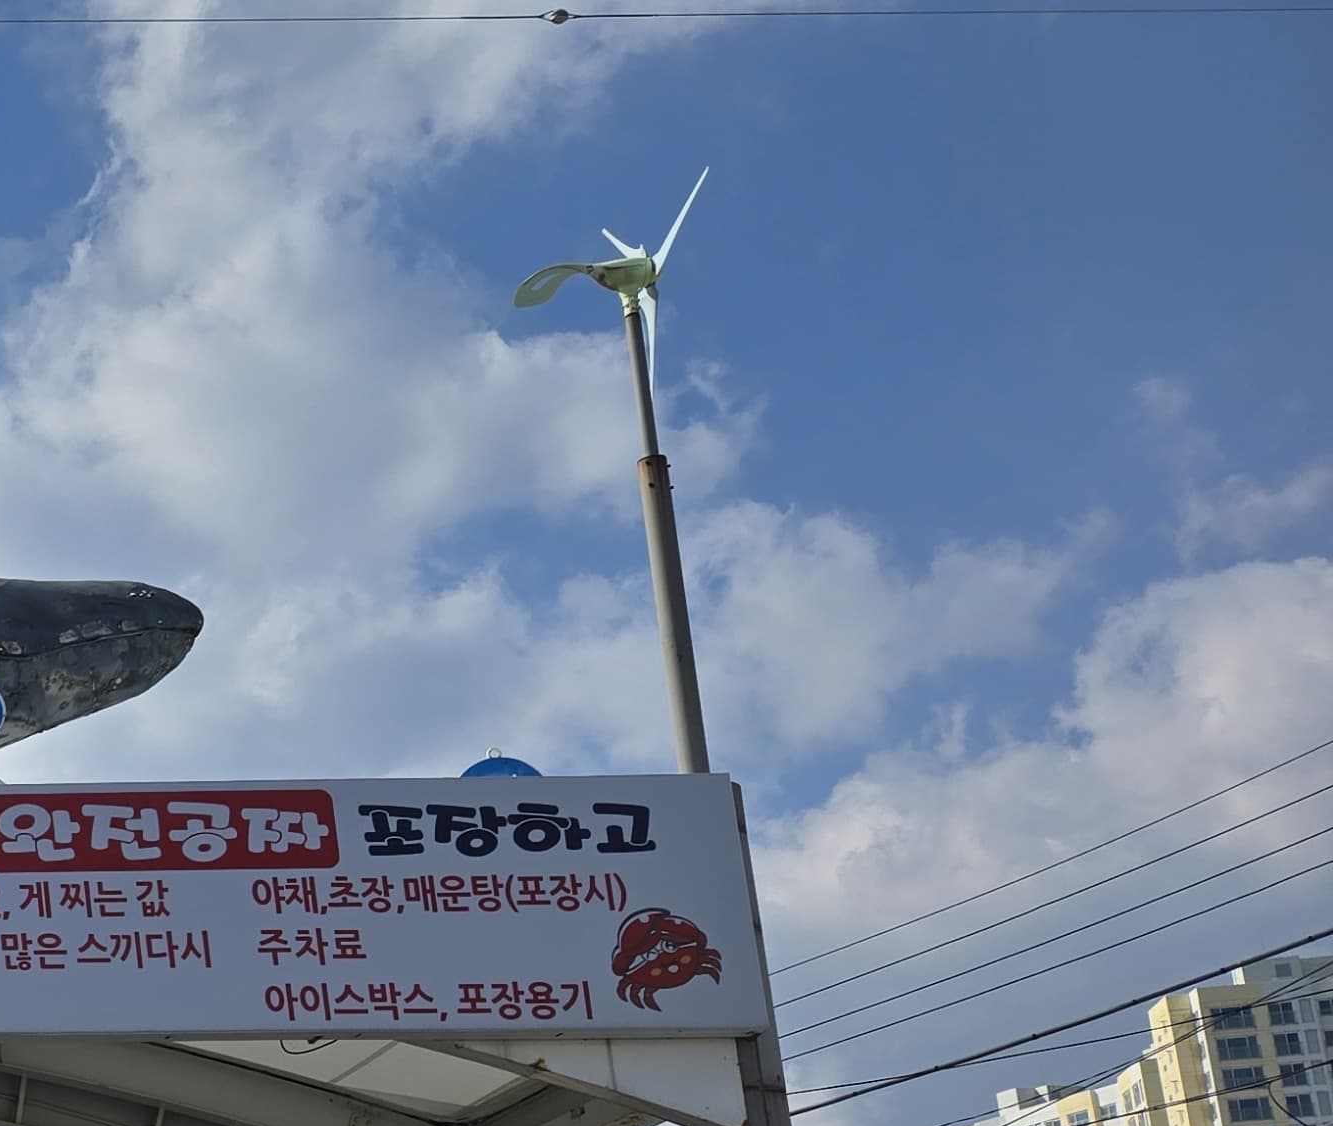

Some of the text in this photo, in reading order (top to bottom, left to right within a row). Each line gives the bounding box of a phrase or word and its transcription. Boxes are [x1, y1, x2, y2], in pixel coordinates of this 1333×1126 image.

[359, 802, 657, 857] 포장하고
[19, 879, 53, 920] 게
[60, 877, 130, 918] 찌는
[137, 879, 171, 918] 값
[1, 931, 69, 972] 많은
[76, 927, 214, 971] 스끼다시
[257, 927, 368, 966] 주차료
[264, 980, 594, 1025] 아이스박스, 포장용기
